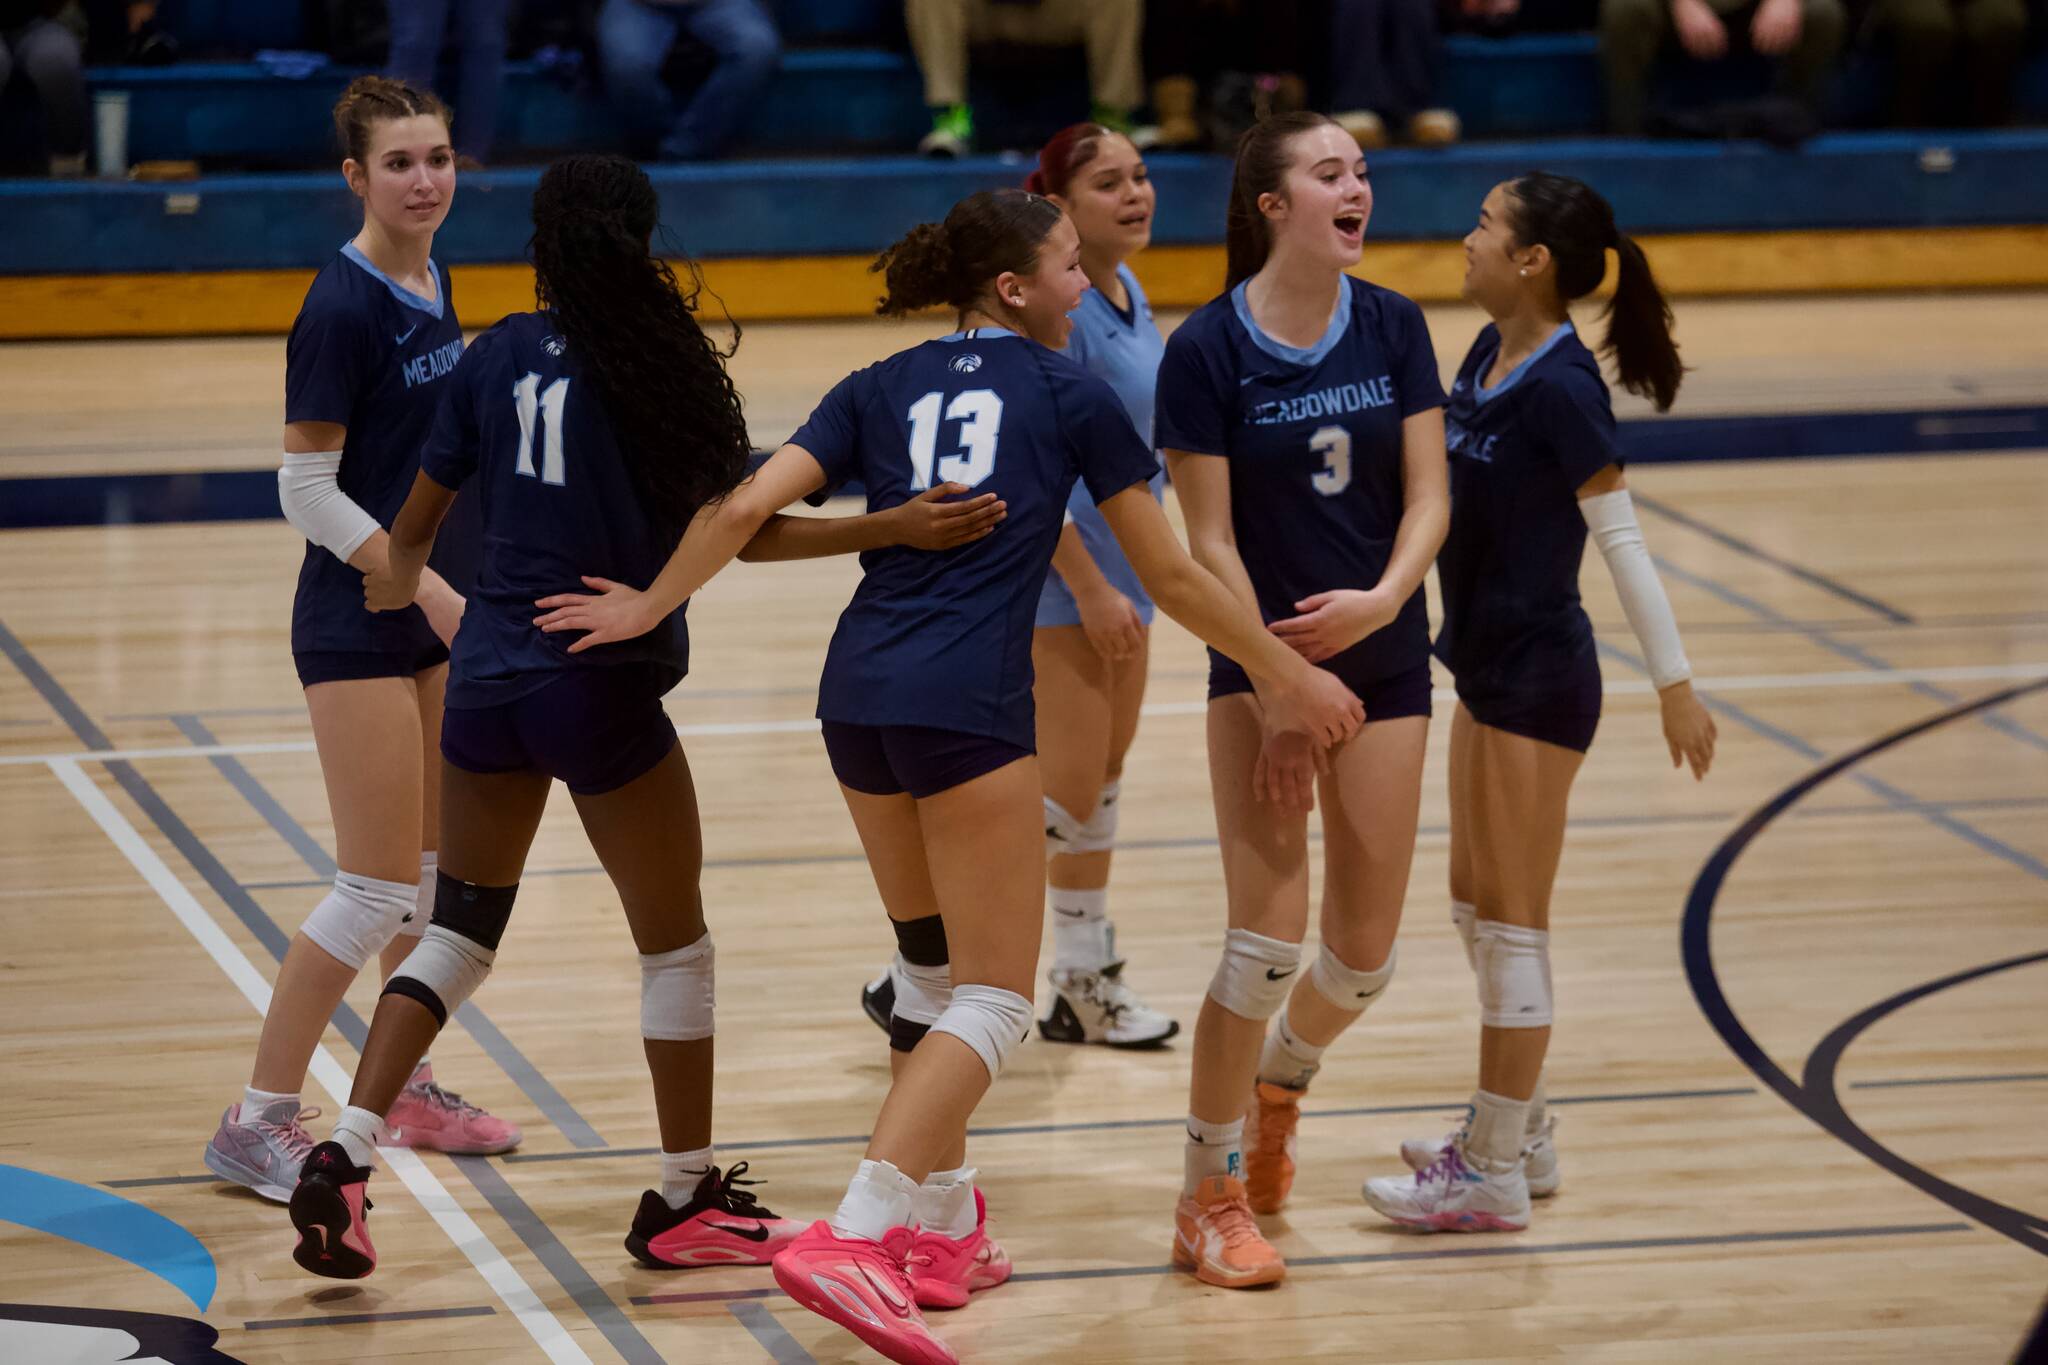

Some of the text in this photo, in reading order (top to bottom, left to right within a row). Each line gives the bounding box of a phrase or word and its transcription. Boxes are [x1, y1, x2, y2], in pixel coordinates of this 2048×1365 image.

[512, 370, 571, 487] 11
[907, 388, 1004, 491] 13
[1308, 424, 1353, 497] 3
